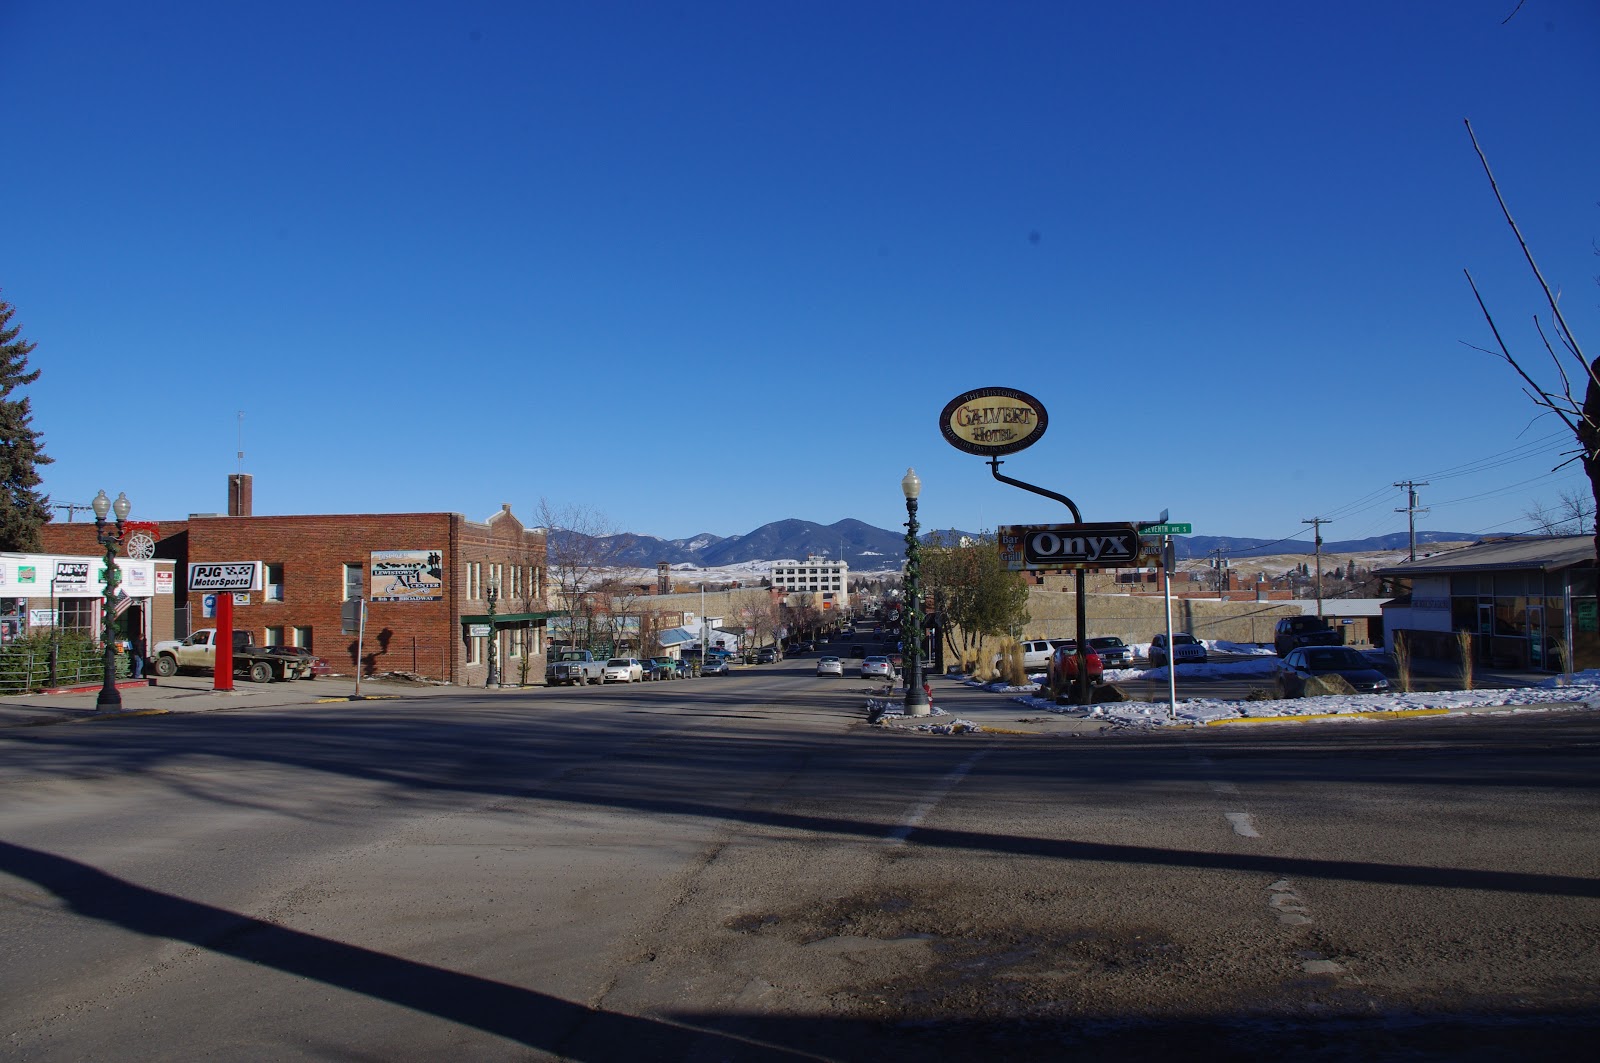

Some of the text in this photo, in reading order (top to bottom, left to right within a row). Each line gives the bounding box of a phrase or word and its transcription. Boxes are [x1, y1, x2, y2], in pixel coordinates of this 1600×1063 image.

[964, 389, 1022, 402] THE HISTORIC
[956, 405, 1036, 427] CALVERT
[971, 427, 1018, 442] HOTEL
[1144, 525, 1169, 533] SEVENTH
[1002, 535, 1019, 544] Bar
[1006, 543, 1015, 552] &
[1031, 532, 1130, 561] Onyx
[1001, 551, 1021, 561] Grill
[58, 564, 73, 574] PJG
[197, 567, 222, 577] PJG
[194, 578, 249, 587] MotorSports
